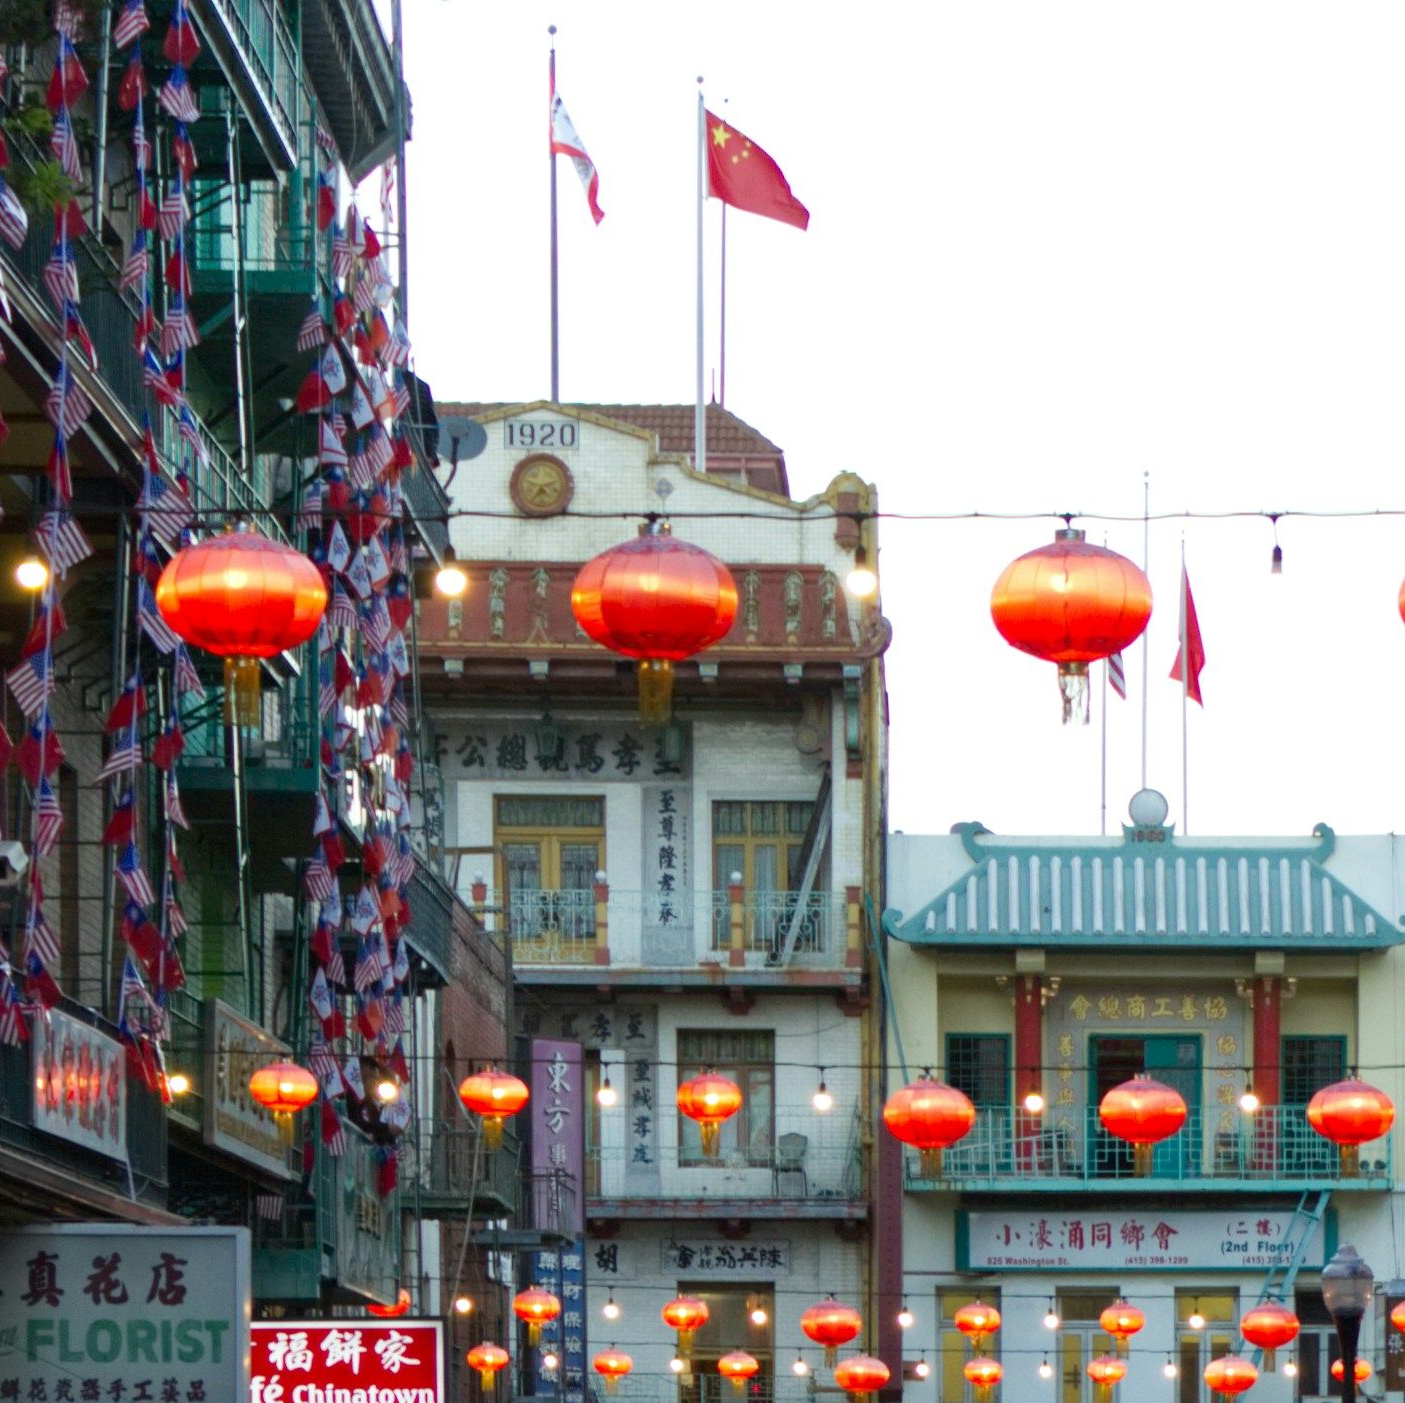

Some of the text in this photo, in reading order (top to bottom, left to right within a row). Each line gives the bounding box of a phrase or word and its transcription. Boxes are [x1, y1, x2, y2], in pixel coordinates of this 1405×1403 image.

[507, 422, 577, 448] 1920
[1005, 1256, 1055, 1268] Washington
[26, 1318, 230, 1365] FLORIST
[251, 1329, 421, 1375] 福餅家
